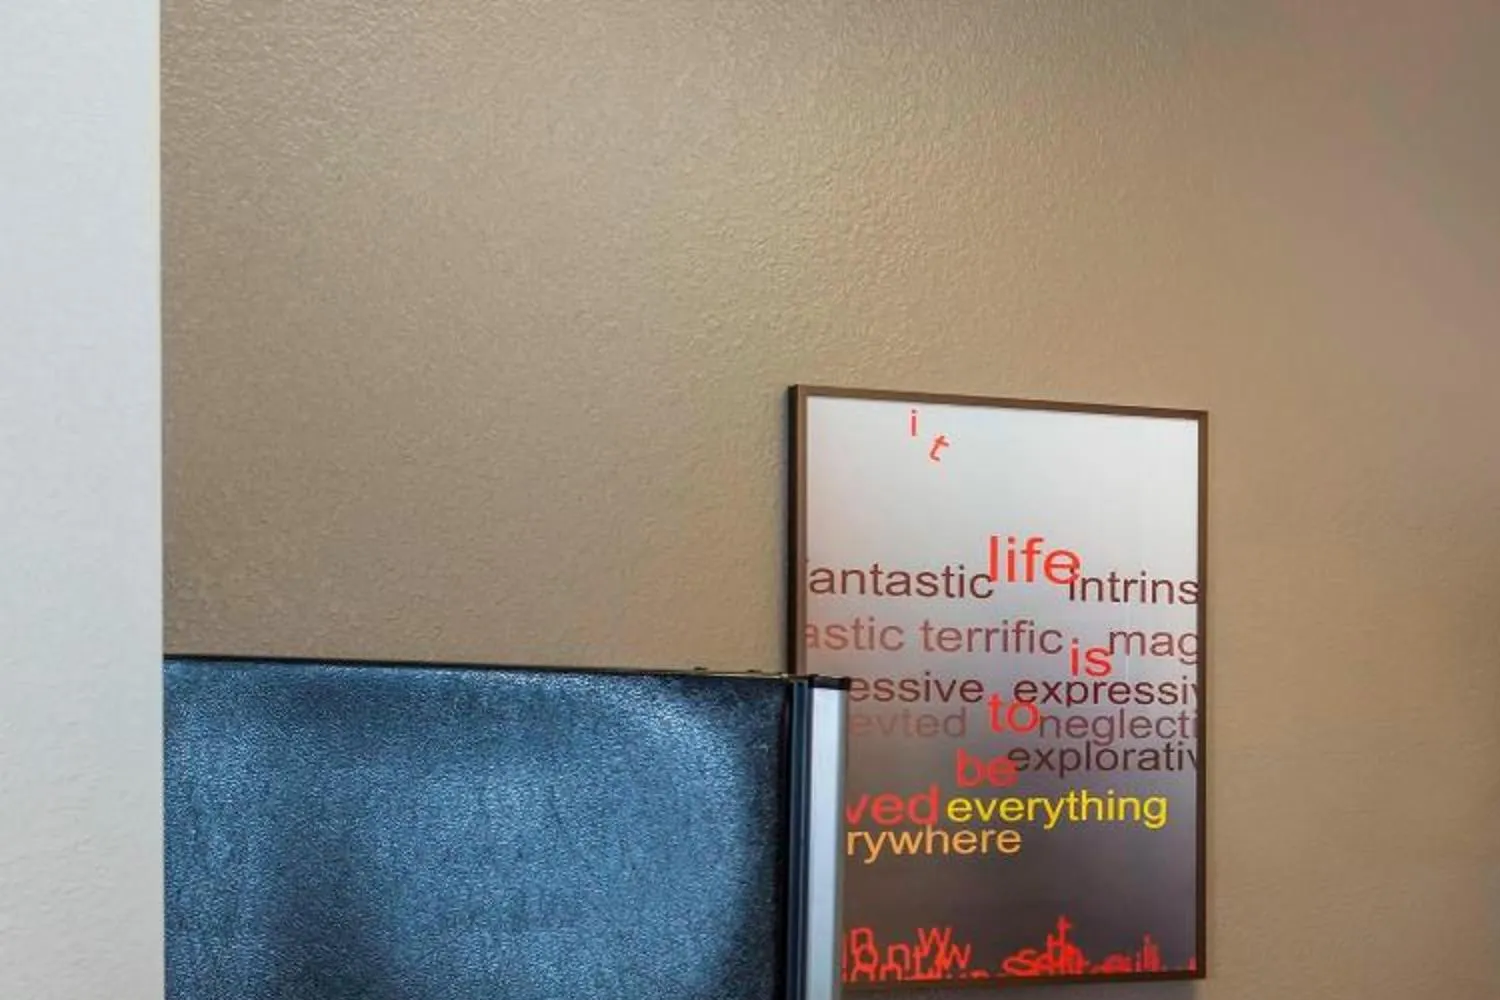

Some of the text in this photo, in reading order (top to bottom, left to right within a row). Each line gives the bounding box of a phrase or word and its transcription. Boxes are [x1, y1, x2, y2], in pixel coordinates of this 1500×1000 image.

[989, 534, 1081, 584] life
[809, 563, 1199, 605] antastic intrins
[805, 615, 904, 652] astic
[919, 619, 1064, 655] terrific
[1071, 638, 1113, 677] is
[850, 671, 984, 703] essive
[988, 693, 1040, 733] to
[956, 748, 1019, 788] be
[846, 784, 1168, 830] ved everything
[847, 825, 1022, 864] rywhere
